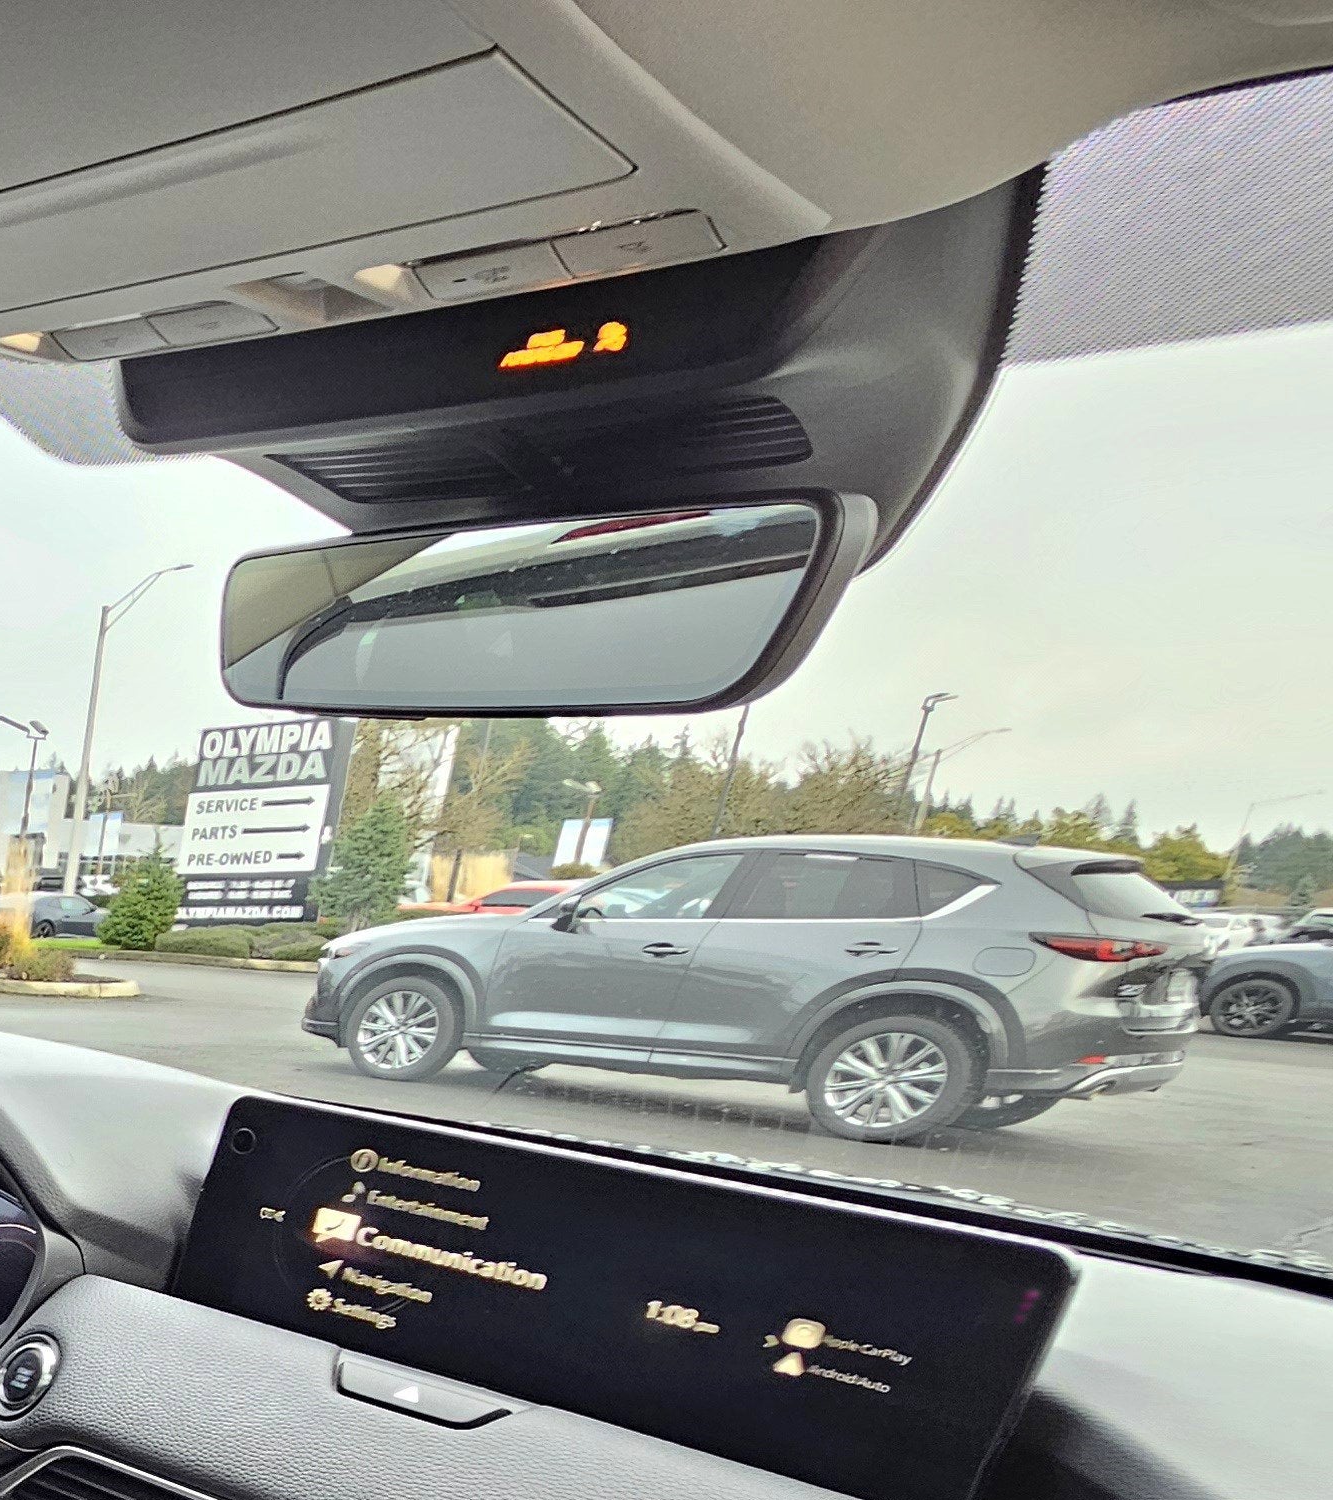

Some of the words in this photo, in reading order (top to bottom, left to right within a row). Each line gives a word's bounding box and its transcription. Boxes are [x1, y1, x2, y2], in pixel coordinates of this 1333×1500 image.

[203, 720, 332, 759] OLYMPIA
[197, 751, 326, 787] MAZDA
[196, 797, 258, 815] SERVICE
[191, 825, 237, 841] PARTS
[187, 851, 272, 866] PRE-OWNED
[355, 1226, 548, 1291] Communication
[859, 1343, 913, 1366] CarPlay
[856, 1376, 892, 1393] Auto
